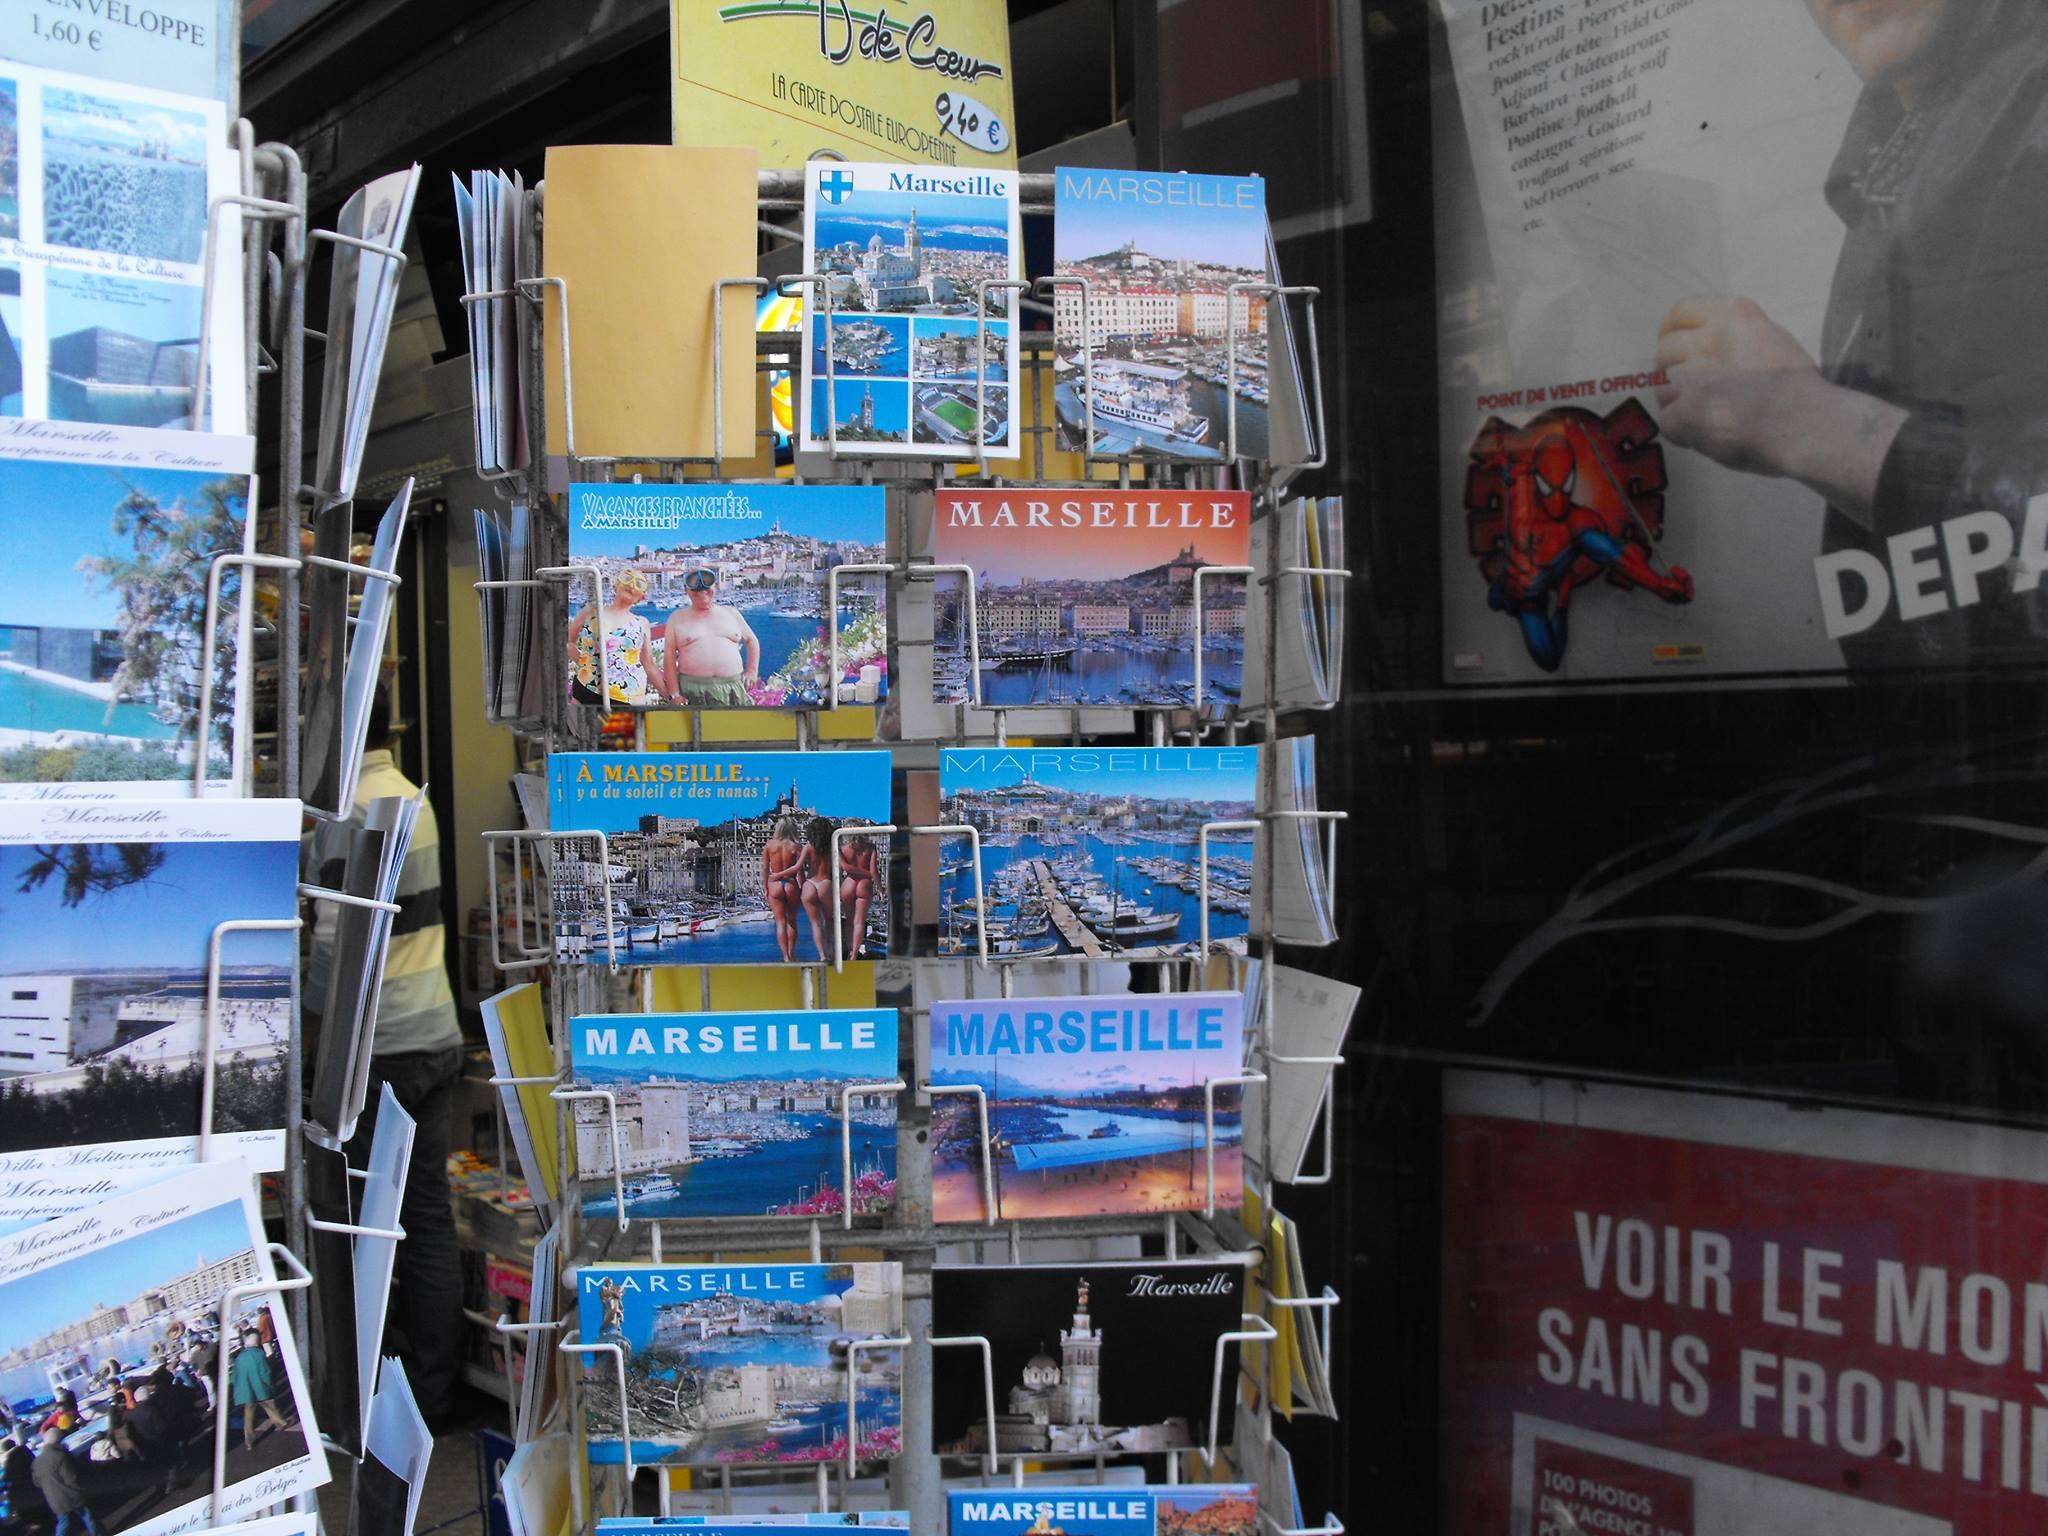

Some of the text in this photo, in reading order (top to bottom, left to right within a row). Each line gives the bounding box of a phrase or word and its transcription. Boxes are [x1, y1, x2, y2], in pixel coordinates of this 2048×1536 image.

[32, 13, 104, 51] 1,60 €
[859, 8, 901, 62] de
[1485, 3, 1565, 52] Festins
[1491, 58, 1551, 97] fromage
[1554, 47, 1573, 65] de
[1575, 36, 1601, 56] tête
[772, 72, 787, 101] LA
[790, 81, 827, 108] CARTE
[829, 94, 884, 139] POSTALE
[1502, 92, 1569, 133] Barbara
[1617, 62, 1635, 82] de
[986, 120, 1001, 146] €
[1507, 82, 1638, 152] Poutine football
[1587, 99, 1653, 138] Godard
[888, 171, 1007, 198] Marseille
[1062, 172, 1259, 210] MARSEILLE
[1477, 368, 1671, 411] POINT DE VENTE OFFICIEL
[582, 492, 661, 519] VACANCES
[596, 517, 671, 530] MARSEILLE
[947, 501, 1237, 529] MARSEILLE
[576, 759, 594, 783] À
[945, 752, 1247, 774] MARSEILLE
[577, 786, 585, 802] y
[590, 786, 599, 799] a
[603, 782, 621, 799] du
[625, 783, 666, 800] soleil
[669, 784, 684, 799] et
[688, 782, 713, 799] des
[716, 786, 760, 799] nanas
[41, 806, 168, 825] Marseille
[585, 1021, 878, 1058] MARSEILLE
[946, 1007, 1225, 1058] MARSEILLE
[0, 1177, 119, 1198] Marseille
[2, 1215, 102, 1257] Marseille
[585, 1271, 806, 1293] MARSEILLE
[1126, 1272, 1234, 1298] Marseille
[1574, 1210, 1733, 1317] VOIR
[1762, 1241, 1844, 1337] LE
[1537, 1306, 1711, 1418] SANS
[962, 1501, 1148, 1522] MARSEILLE
[1543, 1469, 1653, 1517] 100 PHOTOS
